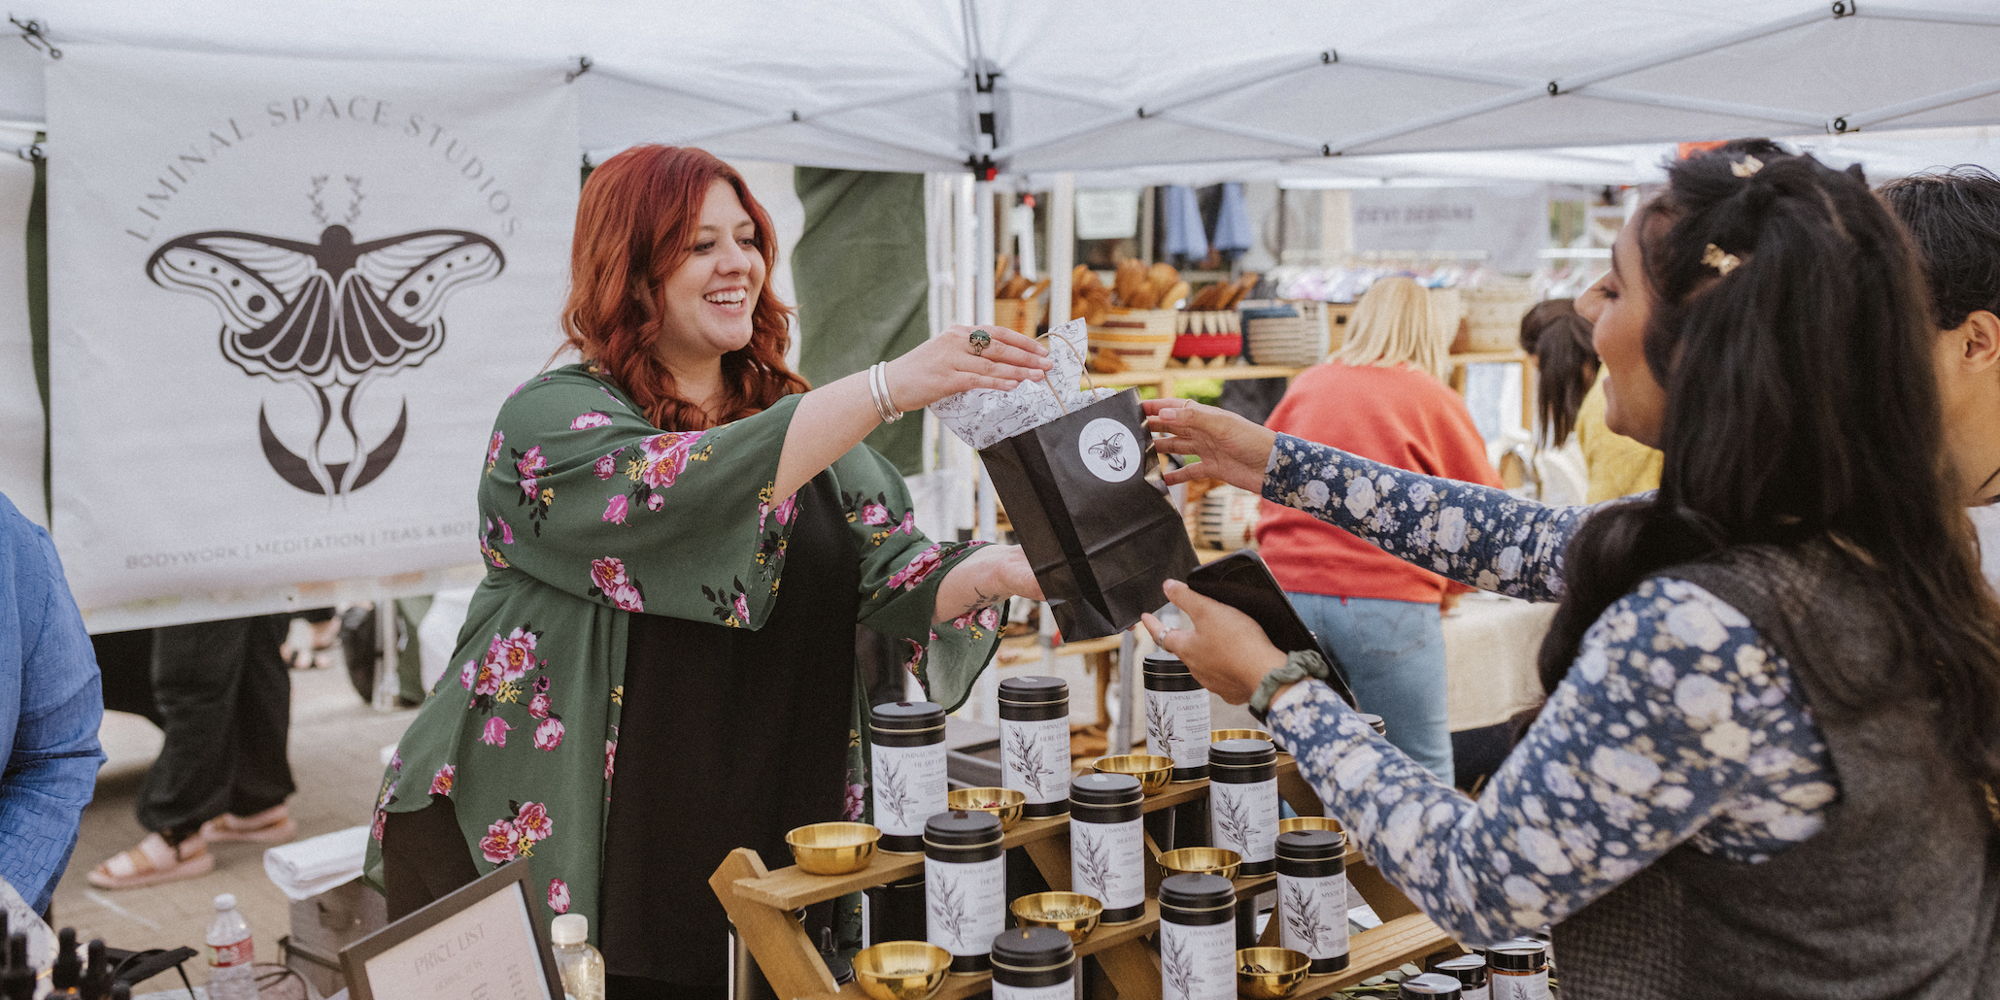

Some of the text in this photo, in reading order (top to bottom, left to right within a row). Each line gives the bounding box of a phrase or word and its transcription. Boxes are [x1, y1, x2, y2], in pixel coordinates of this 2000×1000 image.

[126, 95, 522, 241] LIMINAL SPACE STUDIOS
[125, 548, 239, 569] BODYWORK
[255, 531, 366, 555] MEDITATION
[457, 923, 486, 952] LIST
